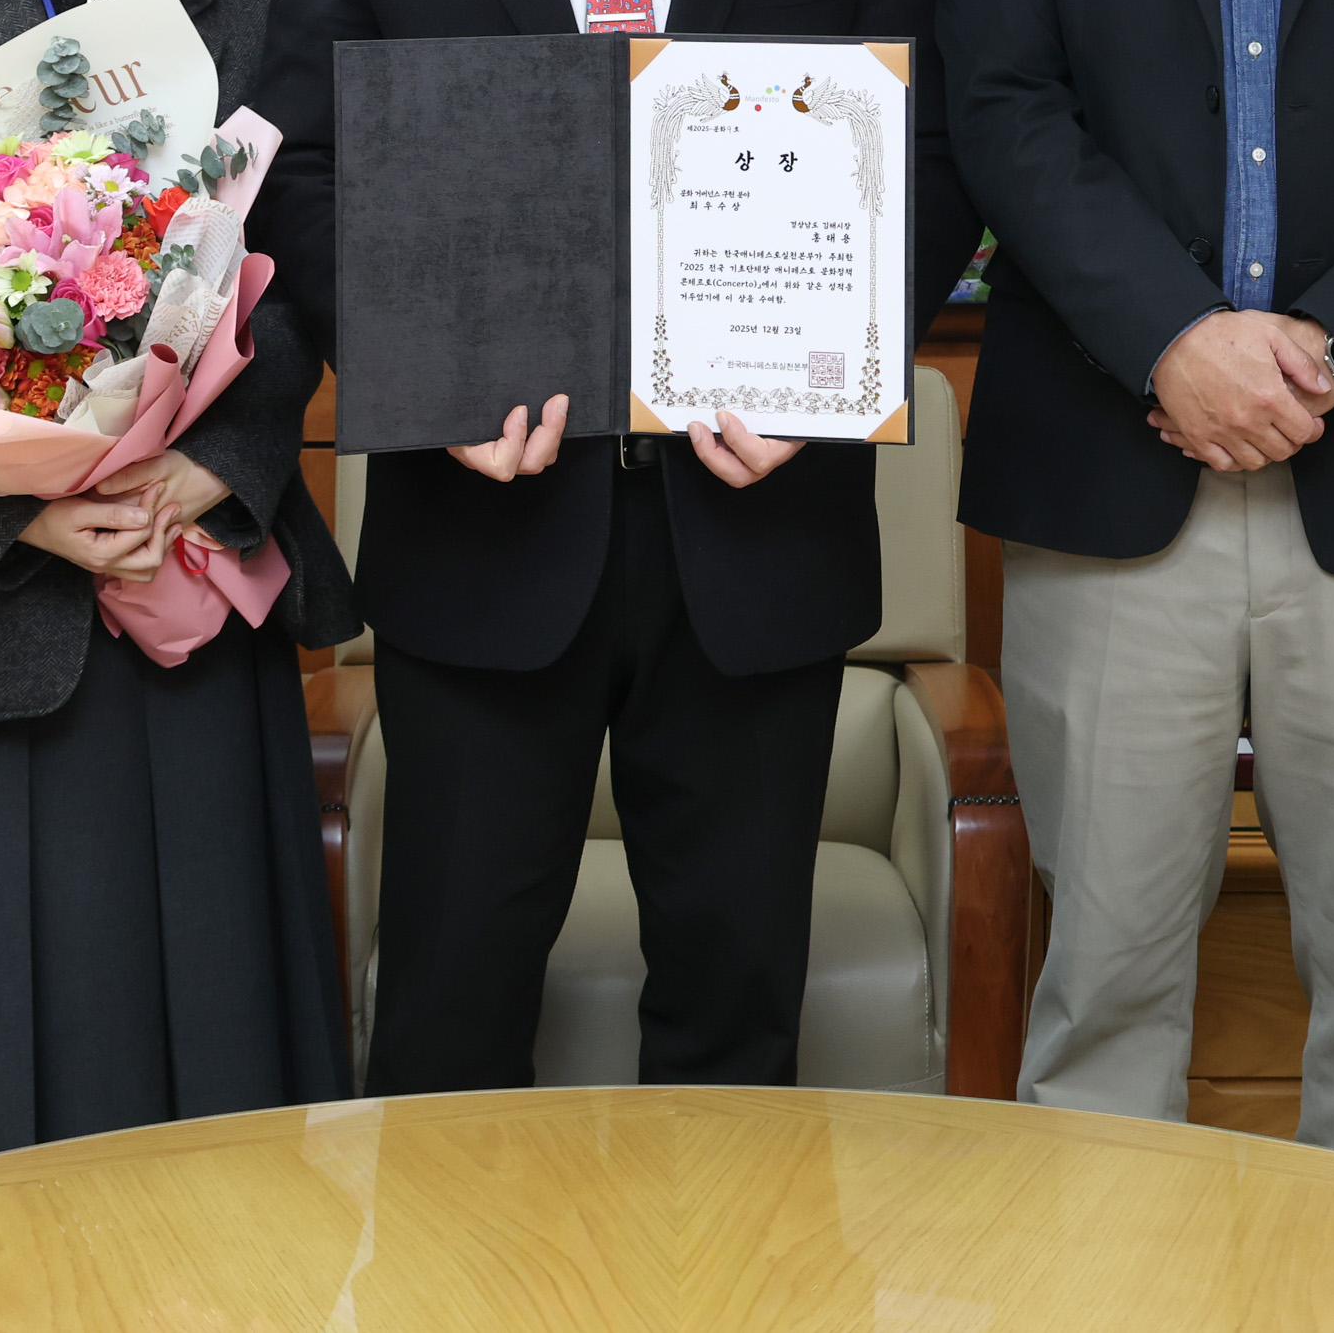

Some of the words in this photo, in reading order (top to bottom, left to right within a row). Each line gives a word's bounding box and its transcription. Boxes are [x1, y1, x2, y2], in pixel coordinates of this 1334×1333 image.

[744, 95, 780, 103] Manifesto
[680, 189, 693, 198] 문화
[695, 190, 721, 198] 거버넌스
[722, 190, 735, 198] 구현
[737, 191, 750, 199] 분야
[790, 221, 819, 230] 경상남도
[822, 221, 851, 231] 김해시장
[693, 248, 718, 258] 귀하는
[723, 249, 823, 261] 한국매니페스토실천본부가
[828, 252, 854, 262] 주최한
[708, 263, 725, 273] 전국
[729, 264, 770, 274] 기초단체장
[774, 266, 816, 275] 매니페스토
[820, 267, 853, 277] 문화정책
[783, 281, 801, 290] 위와
[806, 281, 823, 291] 같은
[828, 282, 854, 292] 성적을
[679, 292, 720, 302] 거두었기에
[725, 293, 733, 302] 이
[738, 294, 755, 304] 상을
[729, 324, 758, 333] 2025년
[763, 325, 779, 334] 12월
[784, 326, 802, 335] 23일
[727, 360, 809, 371] 한국매니페스토실천본부
